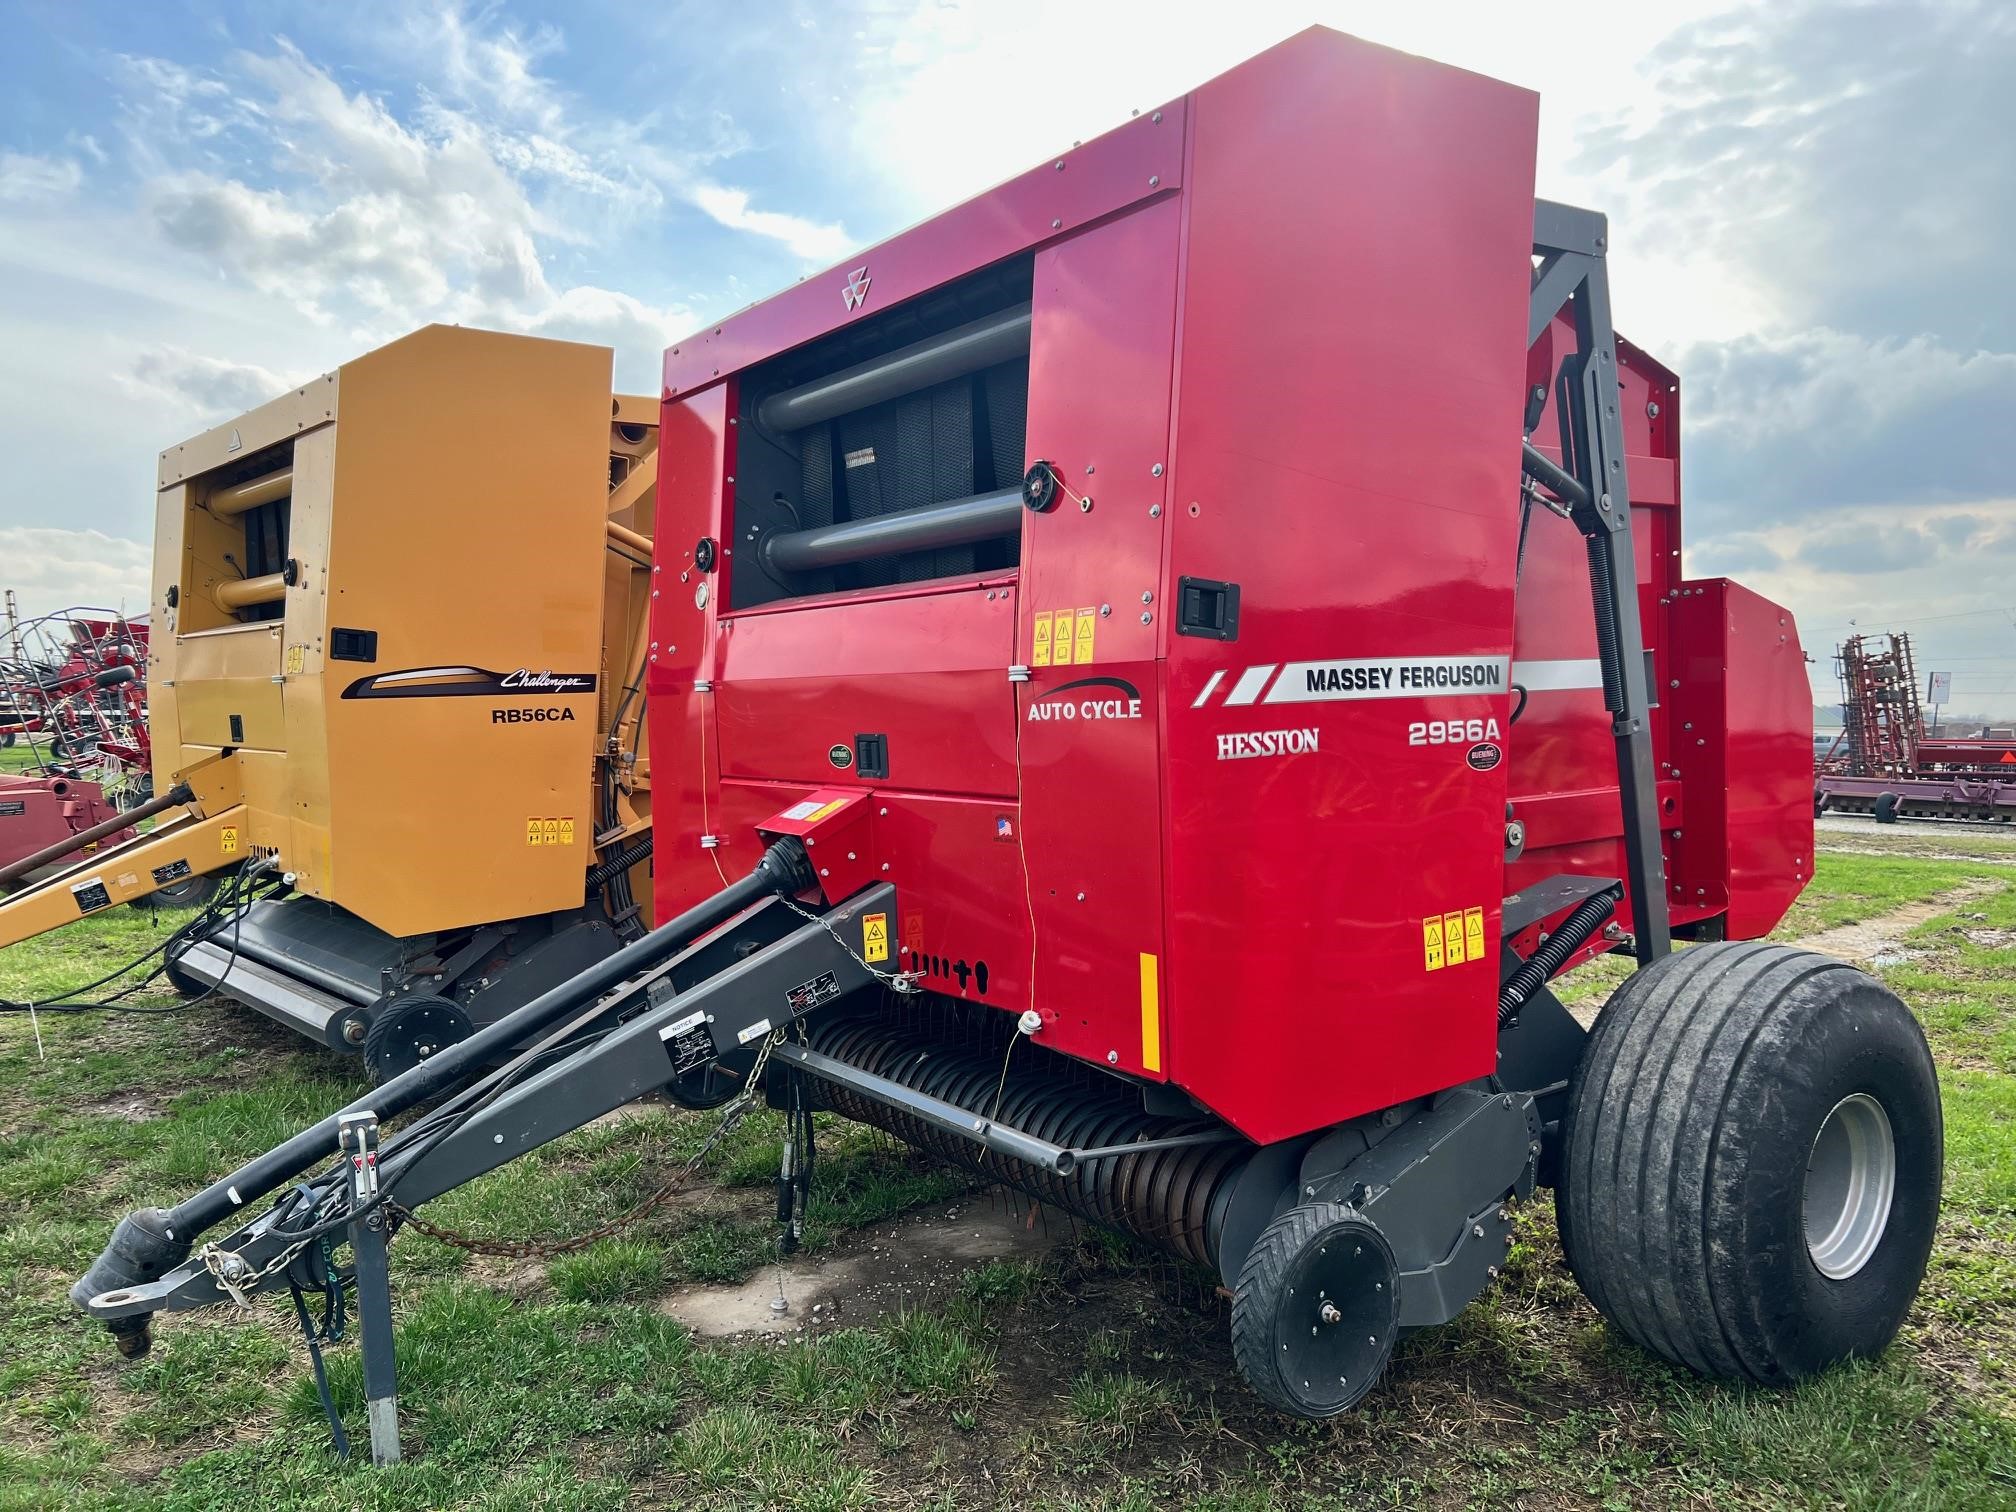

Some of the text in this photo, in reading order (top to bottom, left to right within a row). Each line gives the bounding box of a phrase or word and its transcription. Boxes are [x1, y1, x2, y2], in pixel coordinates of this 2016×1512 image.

[501, 669, 591, 692] Challenger
[1306, 664, 1500, 692] MASSEY FERGUSON
[492, 707, 575, 724] RB56CA
[1028, 699, 1142, 721] AUTO CYCLE
[1216, 727, 1319, 760] HESSTON
[1408, 718, 1501, 746] 2956A
[671, 1018, 694, 1032] NOTICE
